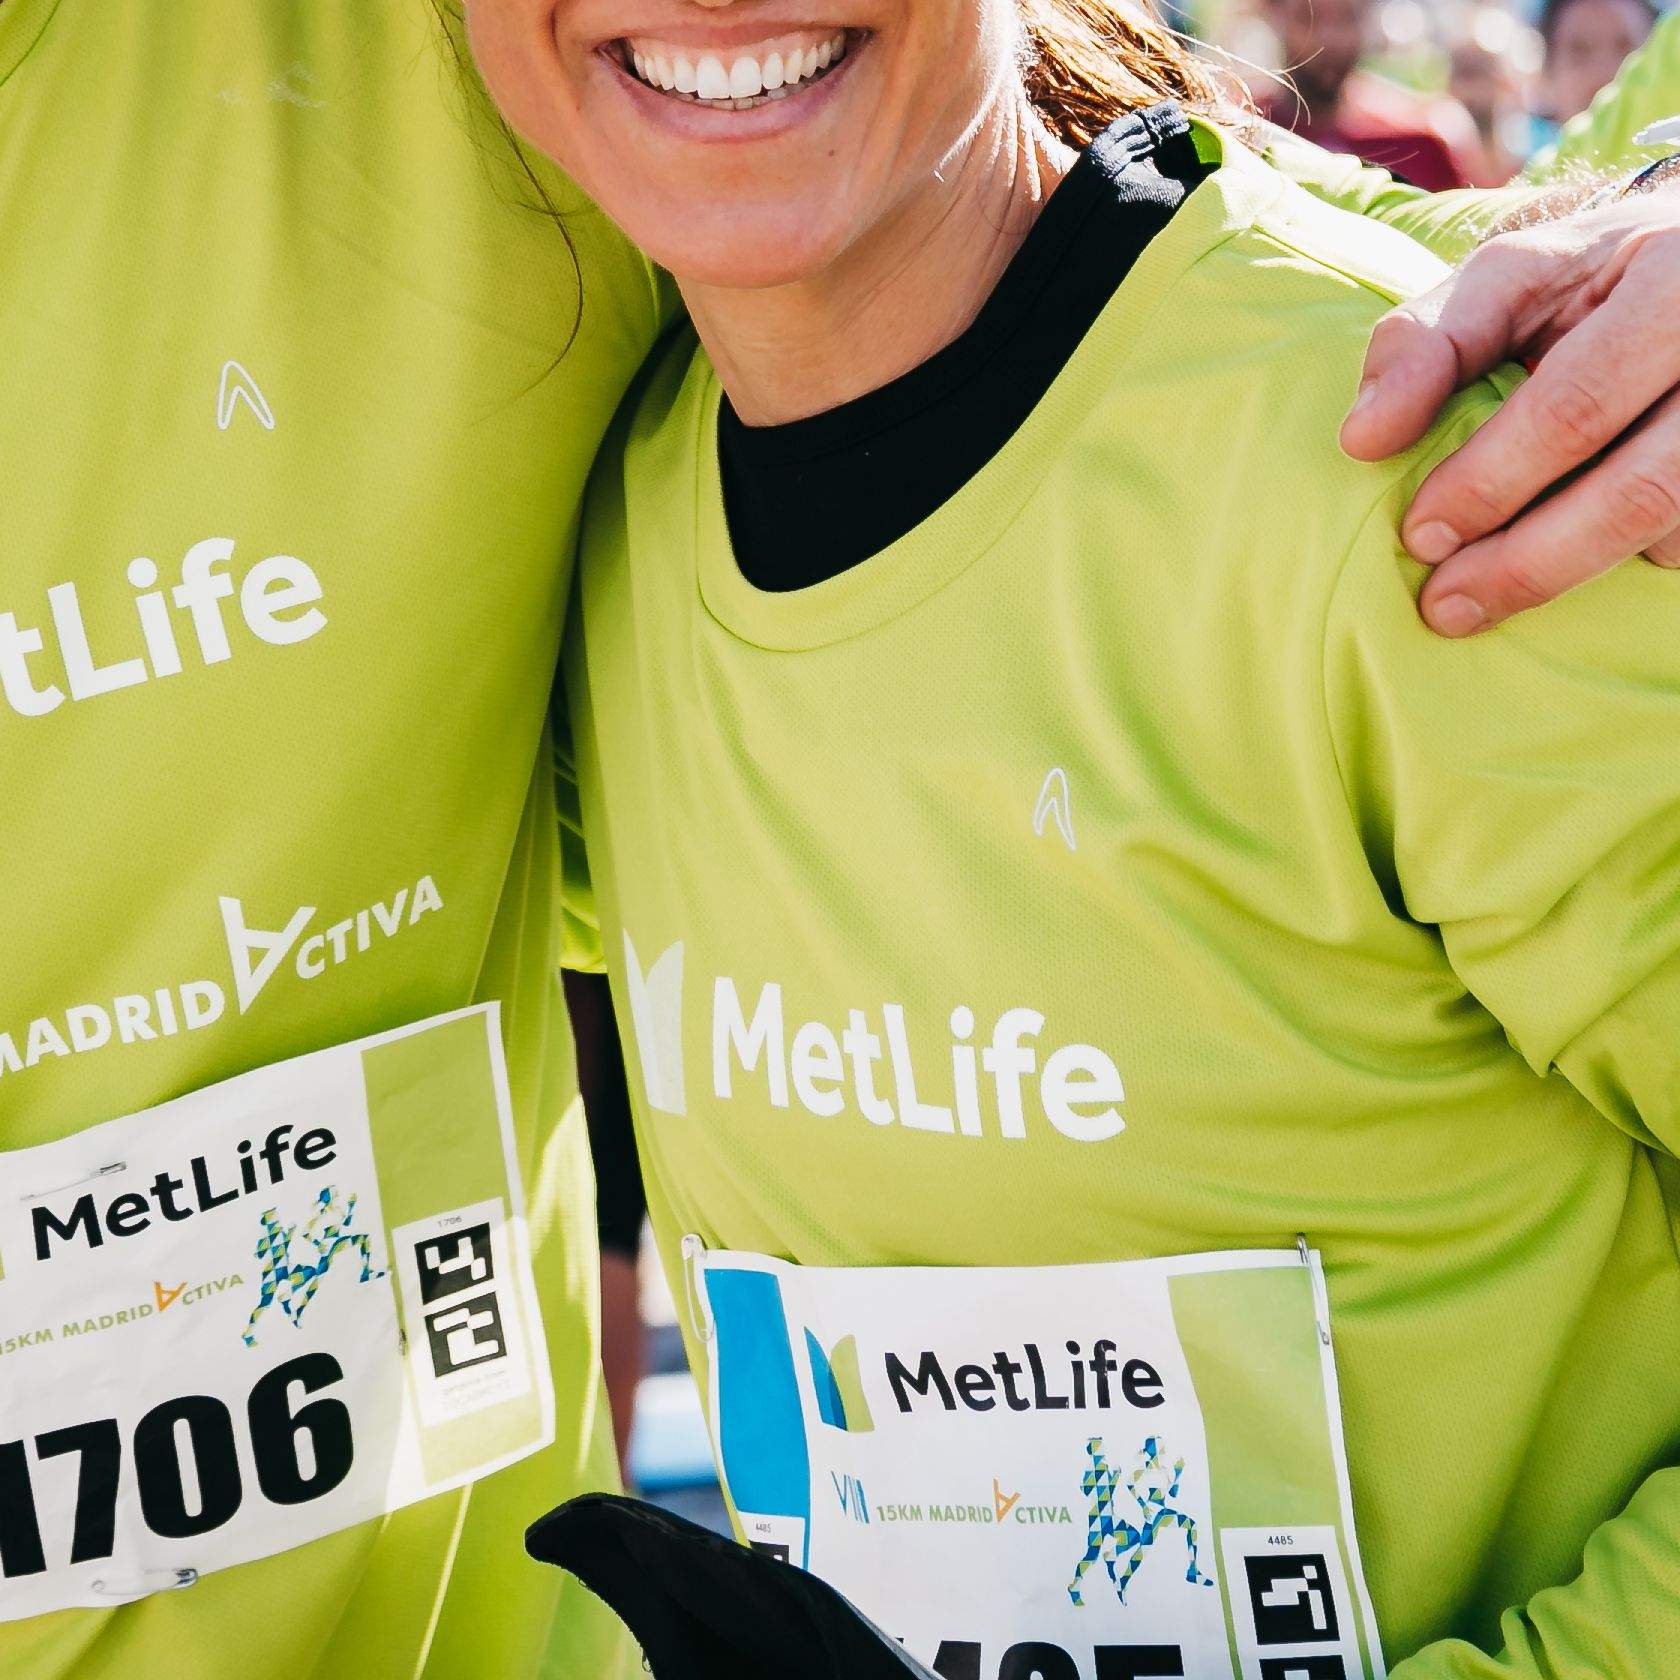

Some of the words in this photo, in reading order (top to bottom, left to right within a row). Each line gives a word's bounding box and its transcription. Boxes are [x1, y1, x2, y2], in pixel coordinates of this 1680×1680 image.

[712, 975, 1126, 1143] MetLife
[29, 1123, 339, 1261] MetLife
[62, 1303, 154, 1339] MADRID
[884, 1338, 1165, 1413] MetLife
[876, 1505, 922, 1522] 15KM
[929, 1505, 993, 1524] MADRID
[1267, 1535, 1294, 1546] 4485
